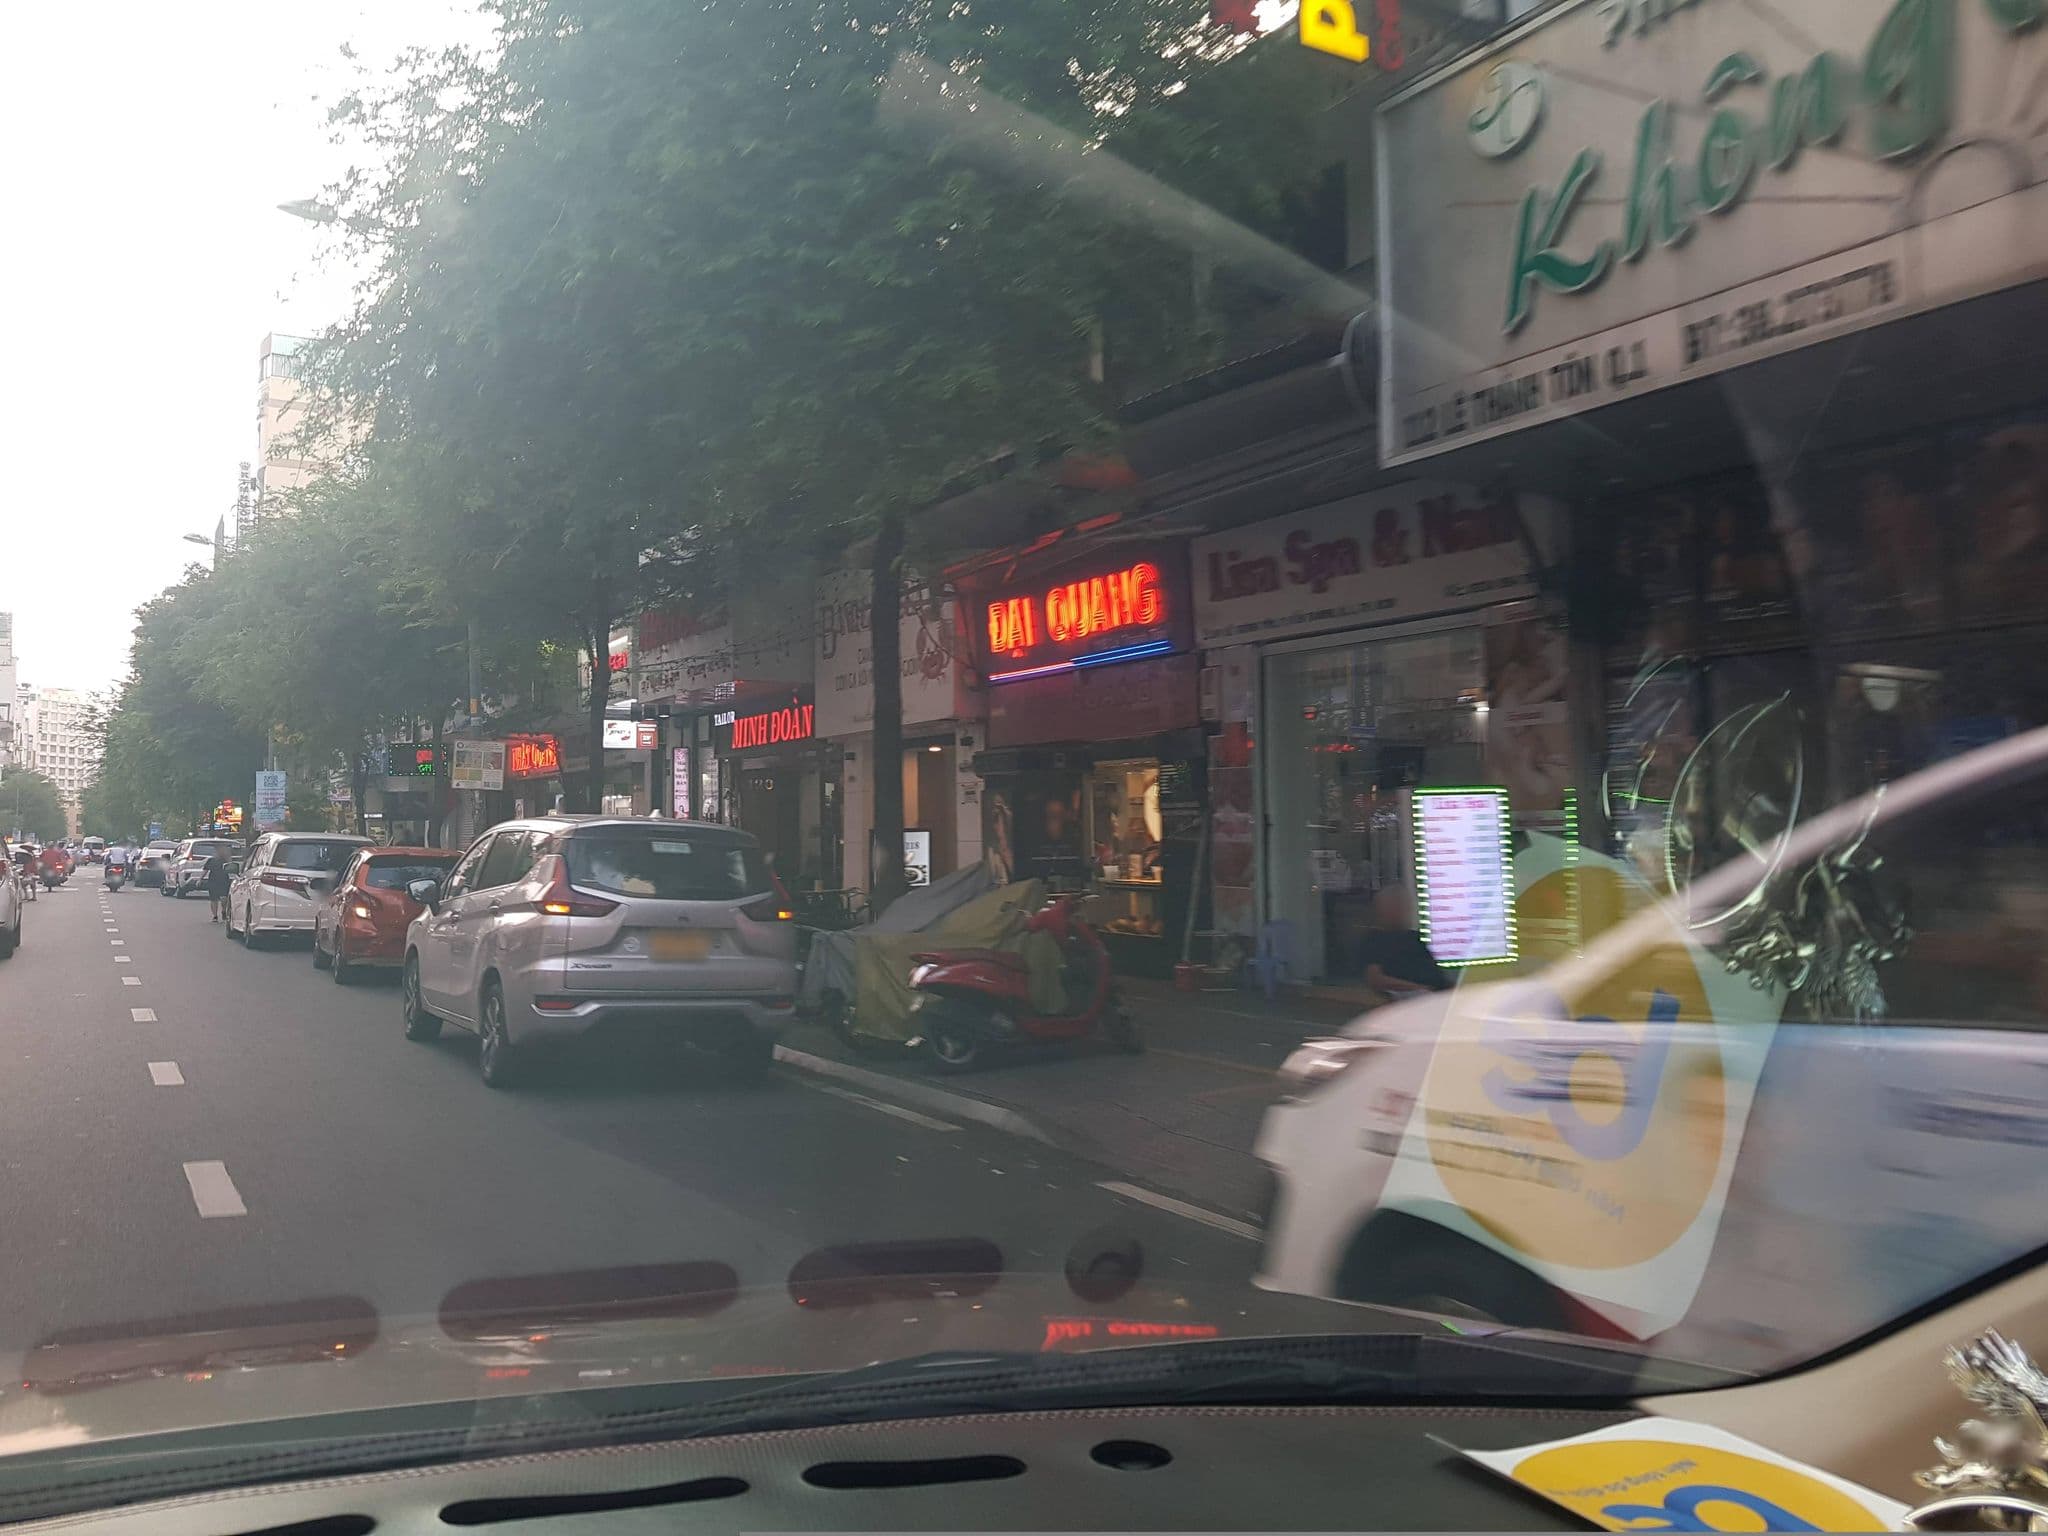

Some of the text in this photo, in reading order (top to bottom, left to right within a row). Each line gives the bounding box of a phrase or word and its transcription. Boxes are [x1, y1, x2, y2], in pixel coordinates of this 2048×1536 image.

[987, 597, 1037, 658] ĐẠI
[1045, 562, 1160, 642] QUANG
[732, 696, 815, 750] MINH ĐOÀN
